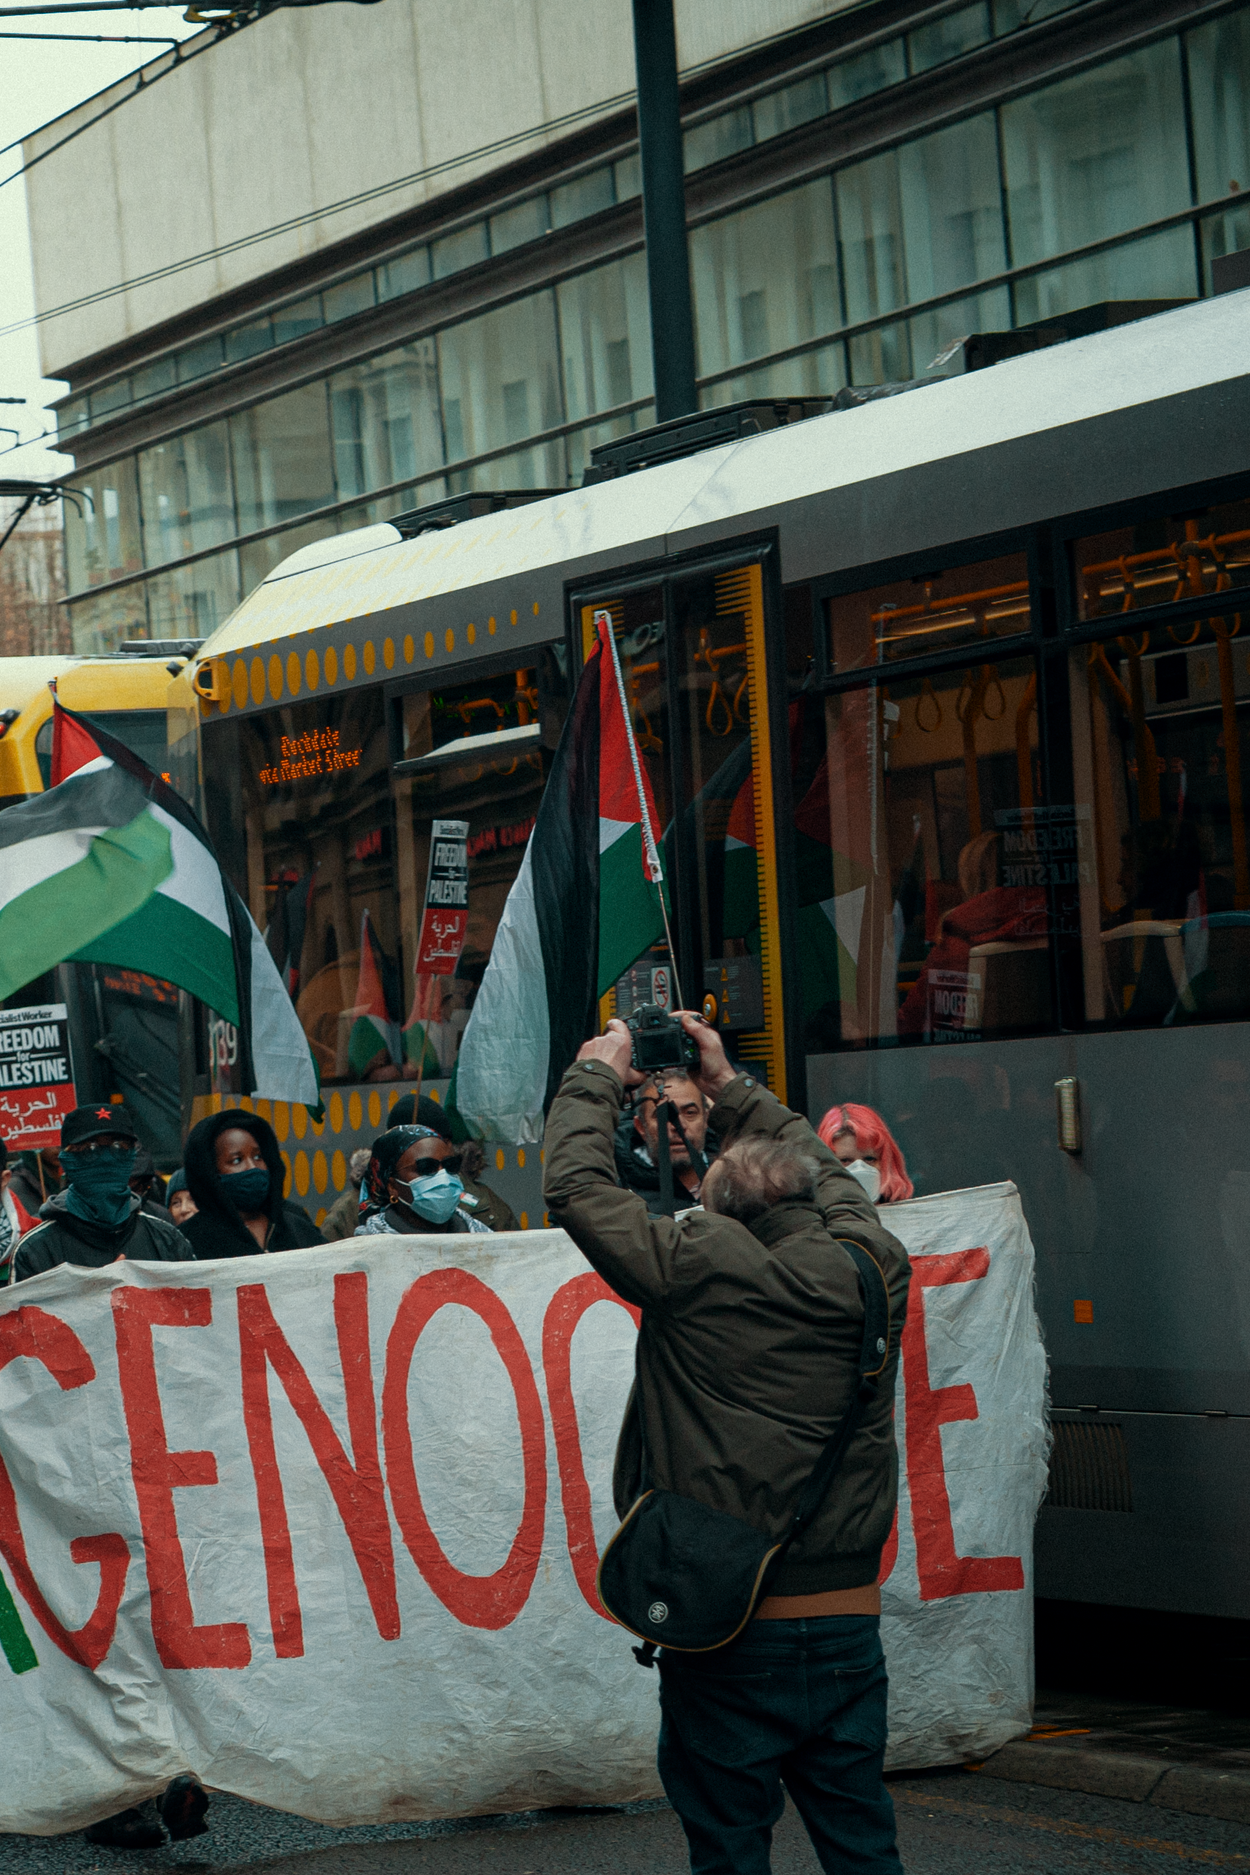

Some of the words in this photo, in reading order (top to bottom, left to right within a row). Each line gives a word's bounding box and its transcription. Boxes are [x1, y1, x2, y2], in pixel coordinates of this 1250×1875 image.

[280, 752, 323, 781] Market
[325, 748, 362, 772] Stree
[22, 1010, 52, 1021] Worker
[16, 1051, 31, 1063] for
[0, 1091, 57, 1117] الحرية
[2, 1113, 66, 1142] لفلسطين
